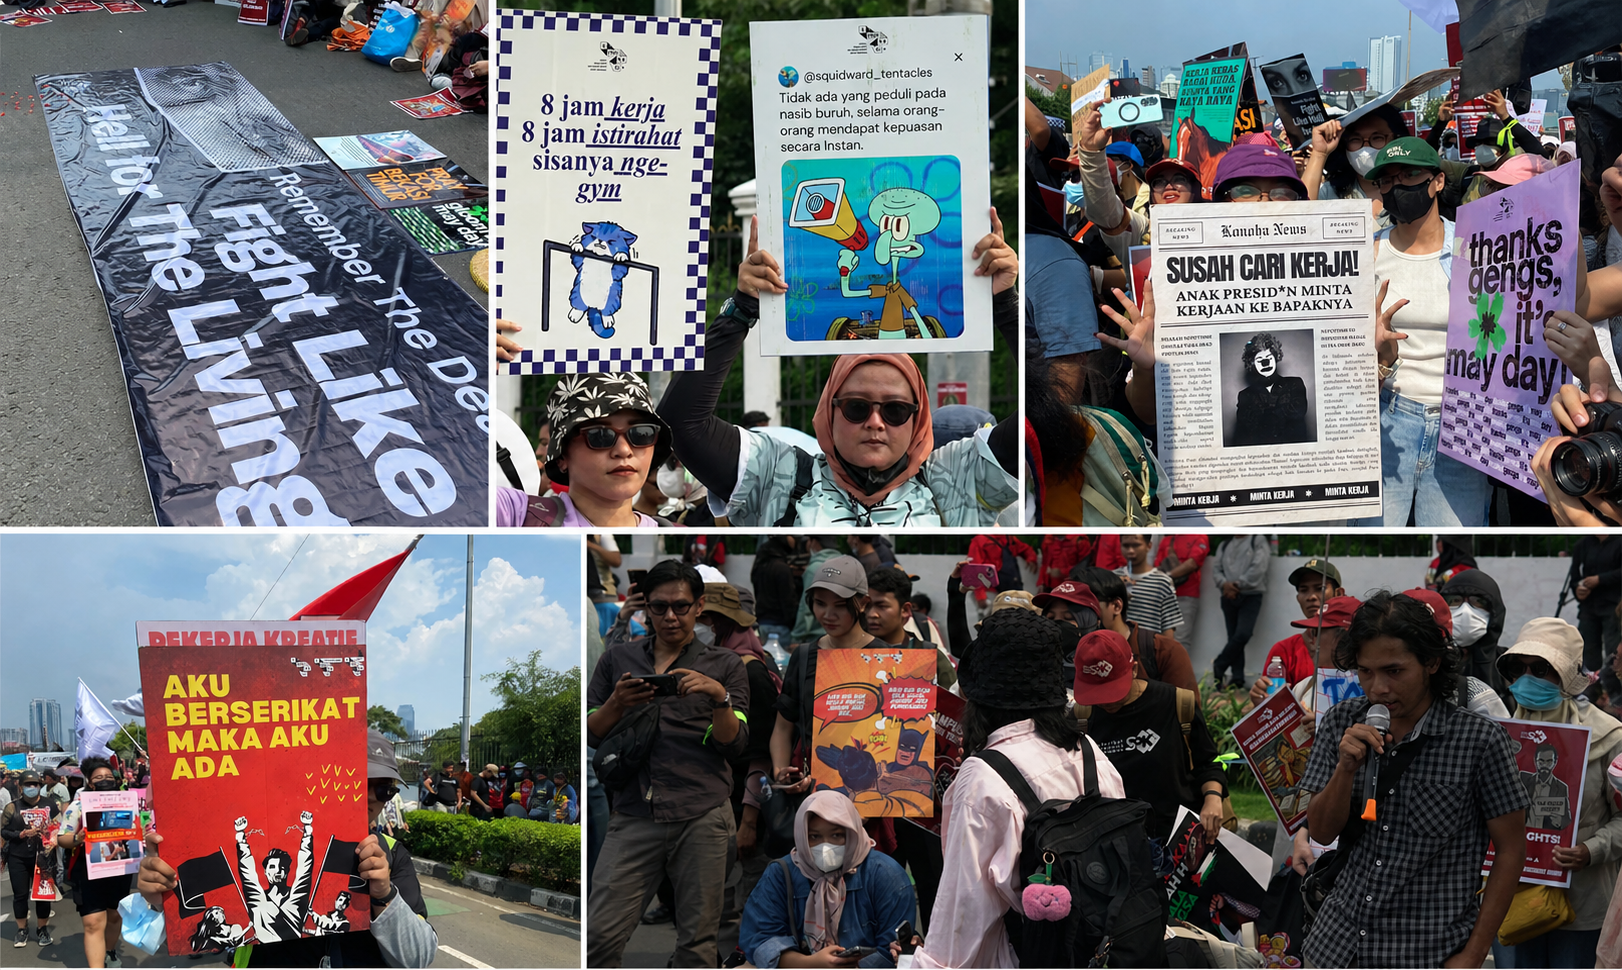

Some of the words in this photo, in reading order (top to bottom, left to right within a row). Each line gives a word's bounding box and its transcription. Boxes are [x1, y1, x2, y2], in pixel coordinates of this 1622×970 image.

[803, 67, 933, 85] @squidward_tentacles
[541, 93, 554, 116] 8
[559, 94, 604, 121] jam
[611, 96, 666, 124] kerja
[779, 91, 812, 103] Tidak
[815, 91, 838, 103] ada
[841, 91, 871, 105] yang
[874, 88, 912, 103] peduli
[915, 87, 947, 101] pada
[779, 107, 812, 120] nasib
[816, 107, 854, 120] buruh,
[856, 106, 900, 118] selama
[903, 105, 945, 118] orang-
[84, 104, 152, 152] Hell
[521, 121, 535, 143] 8
[540, 121, 585, 149] jam
[592, 123, 683, 147] istirahat
[780, 125, 815, 138] orang
[817, 122, 880, 137] mendapat
[883, 121, 942, 136] kepuasan
[780, 141, 821, 153] secara
[823, 139, 864, 152] Instan.
[104, 155, 164, 199] for
[533, 149, 614, 177] sisanya
[621, 155, 668, 178] nge-
[366, 171, 408, 201] TIMUR
[383, 168, 432, 200] BEKASI
[408, 172, 443, 192] FOR
[425, 167, 469, 190] PRAY
[575, 181, 622, 204] gym
[432, 204, 464, 225] may
[457, 227, 489, 246] day
[1273, 222, 1307, 236] News
[128, 203, 206, 291] The
[1468, 217, 1563, 268] thanks
[269, 172, 386, 285] Remember
[373, 287, 438, 350] The
[1166, 254, 1235, 284] SUSAH
[1239, 252, 1286, 281] CARI
[1290, 250, 1360, 279] KERJA!
[1176, 288, 1221, 302] ANAK
[1301, 284, 1353, 298] MINTA
[1468, 255, 1562, 305] gengs,
[1177, 302, 1246, 319] KERJAAN
[1249, 301, 1270, 313] KE
[1273, 298, 1354, 313] BAPAKNYA
[209, 203, 340, 323] Fight
[293, 329, 458, 517] Like
[1446, 348, 1497, 392] may
[167, 299, 352, 526] Living
[1173, 496, 1196, 507] MINTA
[1250, 491, 1273, 502] MINTA
[1273, 490, 1295, 501] KERJA
[1325, 486, 1348, 497] MINTA
[163, 673, 231, 699] AKU
[164, 697, 361, 727] BERSERIKAT
[168, 726, 263, 753] MAKA
[269, 724, 330, 748] AKU
[171, 755, 240, 781] ADA
[1526, 832, 1561, 845] GHTS!
